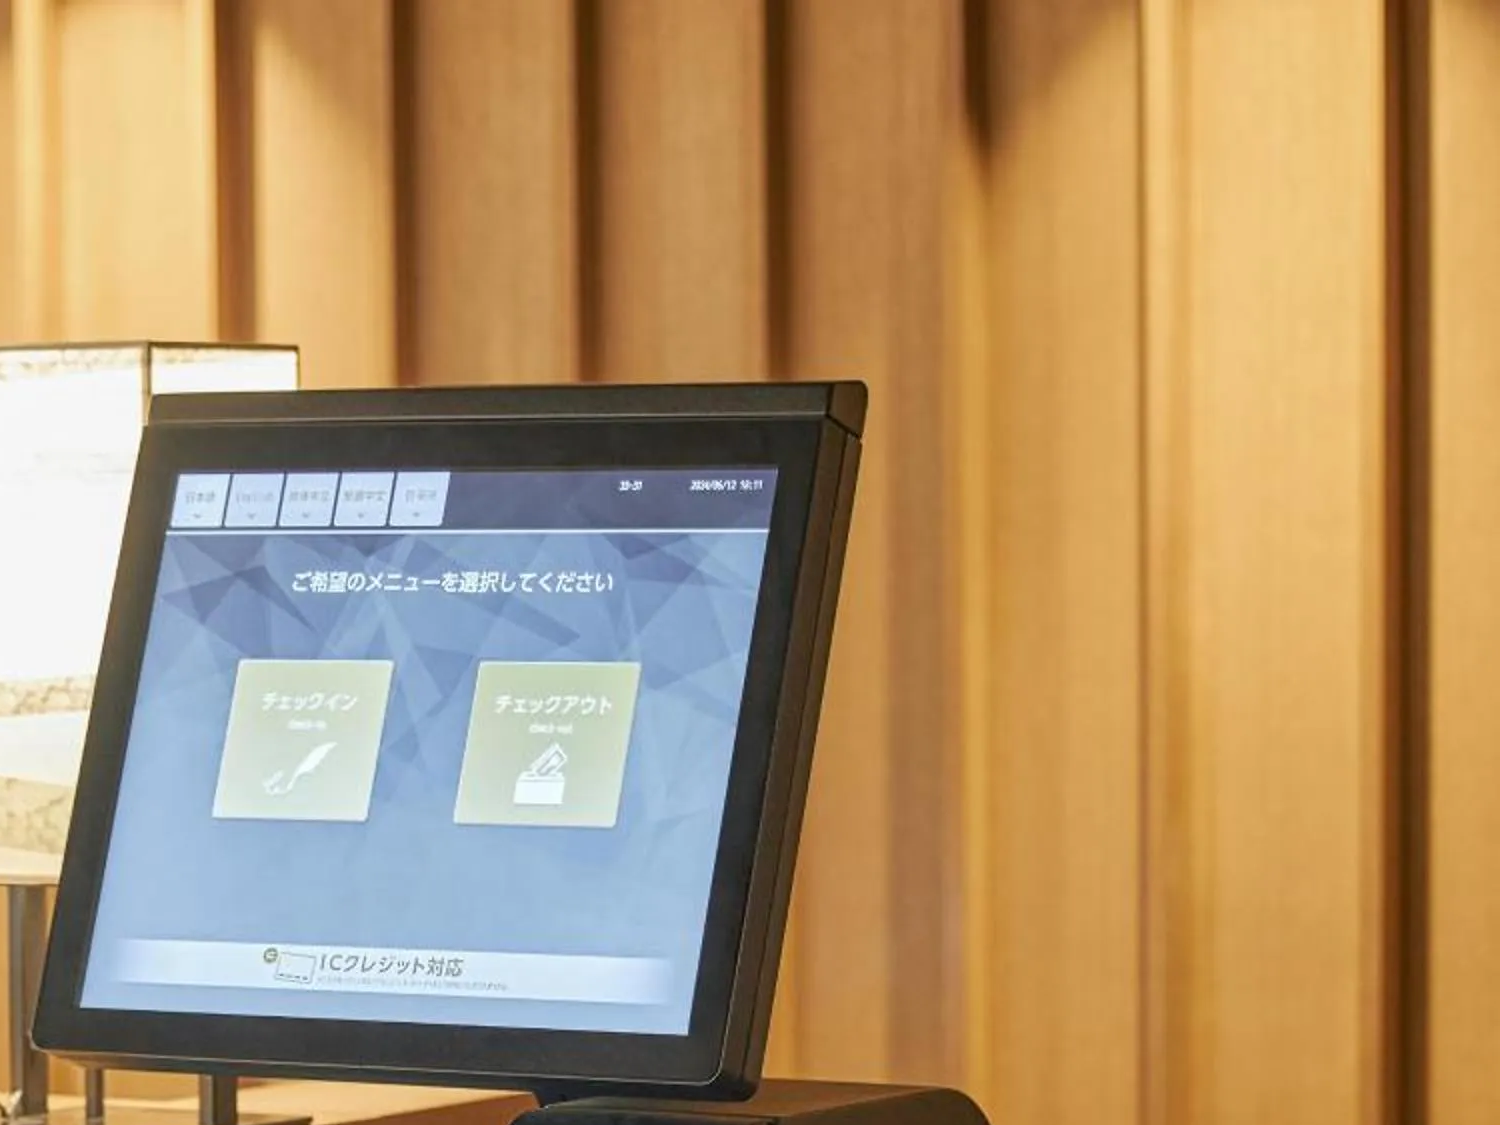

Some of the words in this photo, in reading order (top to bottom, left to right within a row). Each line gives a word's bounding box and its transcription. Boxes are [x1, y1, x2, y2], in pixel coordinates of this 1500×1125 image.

[292, 571, 613, 593] ご希望のメニューを選択してください
[261, 692, 357, 712] チェックイン
[494, 694, 612, 716] チェックアウト
[319, 952, 464, 978] ICクレジット対応
